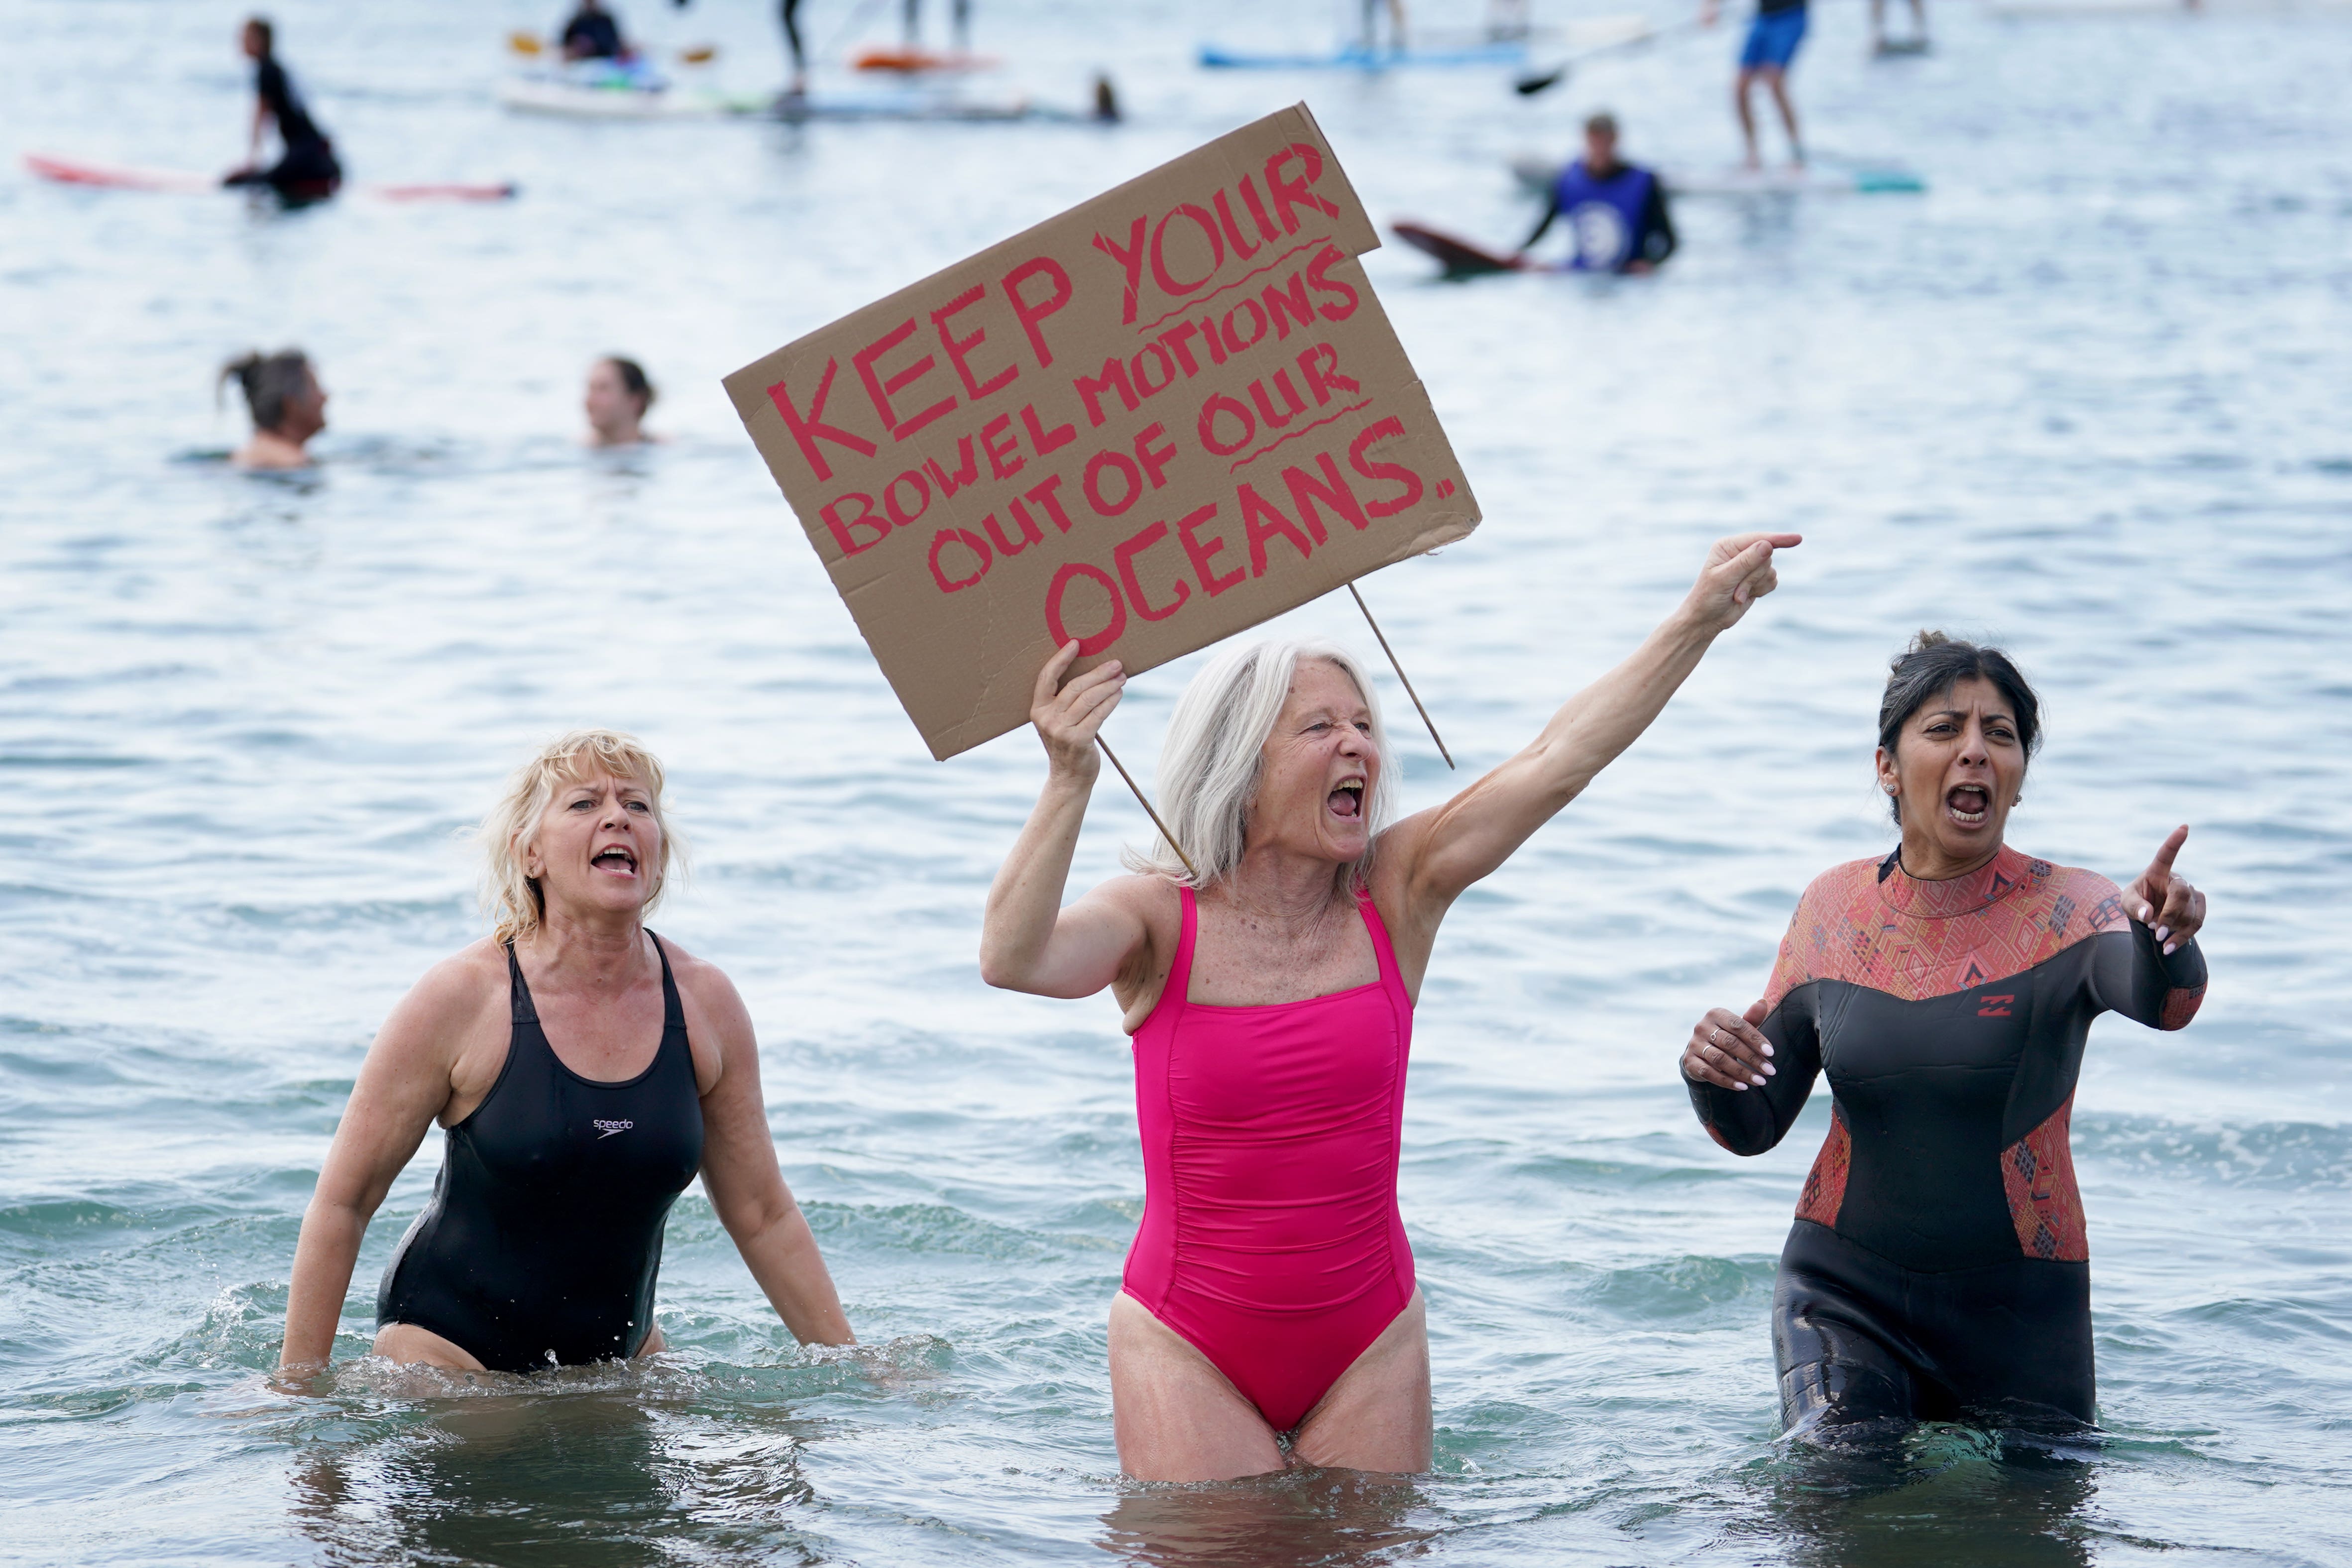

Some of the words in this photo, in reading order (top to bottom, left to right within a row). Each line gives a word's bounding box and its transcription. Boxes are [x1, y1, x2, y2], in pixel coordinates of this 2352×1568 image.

[767, 257, 1073, 482] KEEP
[1092, 143, 1339, 325] YOUR
[819, 404, 1077, 559] BOWEL
[1073, 244, 1358, 428] MOTIONS
[928, 474, 1072, 593] OUT
[1083, 422, 1177, 517] OF
[1198, 342, 1359, 456] OUR
[593, 1119, 633, 1130] speedo
